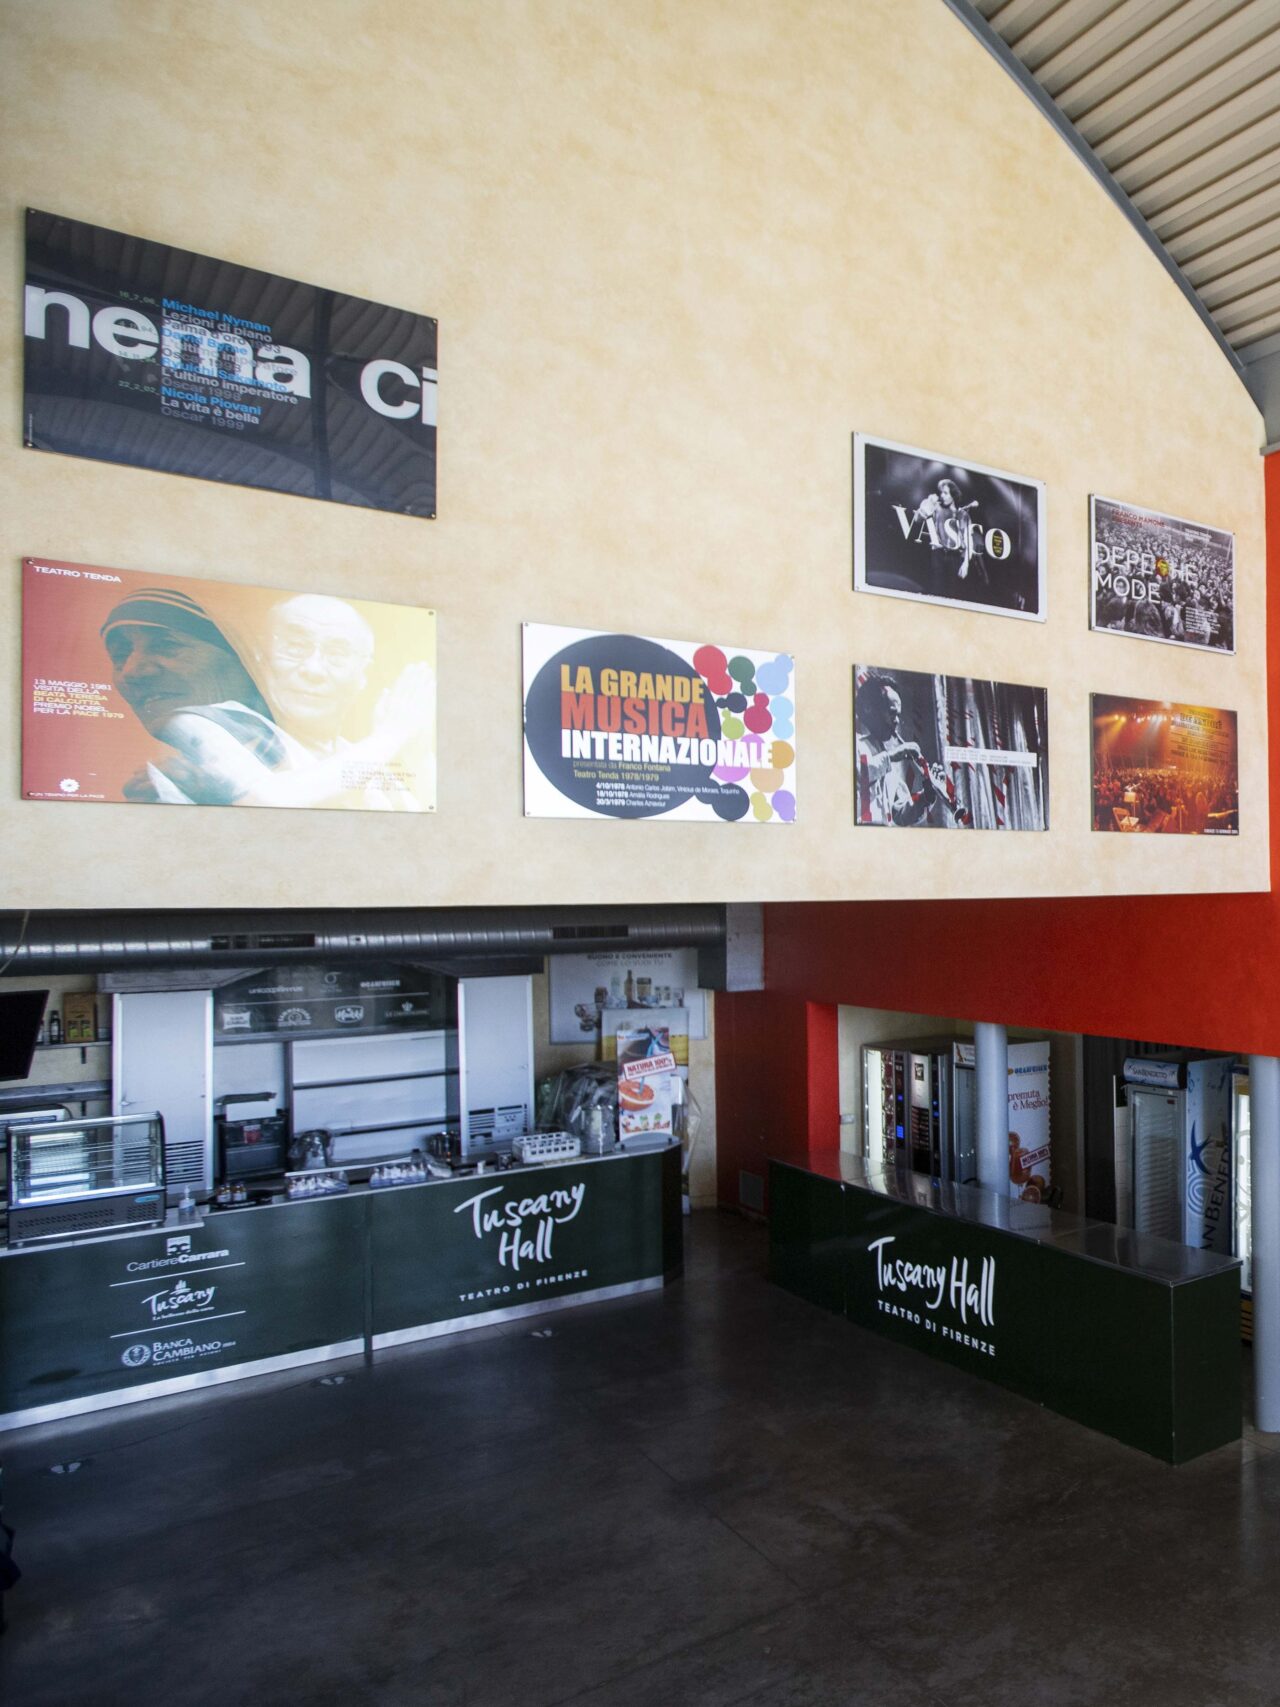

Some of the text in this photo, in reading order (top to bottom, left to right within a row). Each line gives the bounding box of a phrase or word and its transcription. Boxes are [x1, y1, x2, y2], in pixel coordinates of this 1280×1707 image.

[162, 298, 271, 333] Michael Nyman
[162, 308, 214, 329] Lezioni
[217, 320, 230, 333] di
[234, 326, 272, 343] piano
[162, 318, 208, 335] Palma
[25, 284, 310, 399] nema
[161, 328, 248, 356] David Byrne
[162, 348, 204, 364] Oscar
[161, 357, 215, 377] Ryuichi
[218, 368, 288, 393] Sakamoto
[161, 377, 205, 394] Oscar
[162, 367, 298, 405] L'ultimo imperatore
[161, 386, 262, 416] Nicola Piovani
[161, 396, 259, 425] La vita è bella
[161, 406, 205, 422] Oscar
[891, 503, 1011, 560] VASCO
[33, 565, 122, 584] TEATRO TENDA
[1095, 541, 1198, 584] DEPEHE
[1095, 569, 1161, 605] MODE
[33, 684, 100, 695] VISITA DELLA
[33, 690, 108, 701] BEATA TERESA
[48, 680, 87, 689] MAGGIO
[561, 663, 705, 704] LA GRANDE
[33, 701, 72, 710] PREMIO
[33, 707, 53, 715] PER
[73, 710, 99, 718] PACE
[50, 697, 101, 706] CALCUTTA
[561, 690, 709, 739] MUSICA
[561, 728, 773, 769] INTERNAZIONALE
[574, 769, 597, 780] Teatro
[598, 770, 619, 781] Tenda
[618, 762, 642, 772] Franco
[643, 762, 671, 773] Fontana
[588, 952, 613, 960] BUONO
[622, 951, 673, 960] CONVENIENTE
[627, 1059, 653, 1073] NATURA
[1008, 1089, 1041, 1104] premuta
[453, 1182, 586, 1239] Tuscany
[498, 1216, 553, 1271] Hall
[459, 1269, 588, 1301] TEATRO DI FIRENZE
[867, 1235, 996, 1327] Tuscany Hall
[141, 1286, 218, 1316] Tuscany
[877, 1299, 996, 1357] TEATRO DI FIRENZE
[153, 1338, 193, 1352] BANCA
[153, 1341, 221, 1361] CAMBIANO
